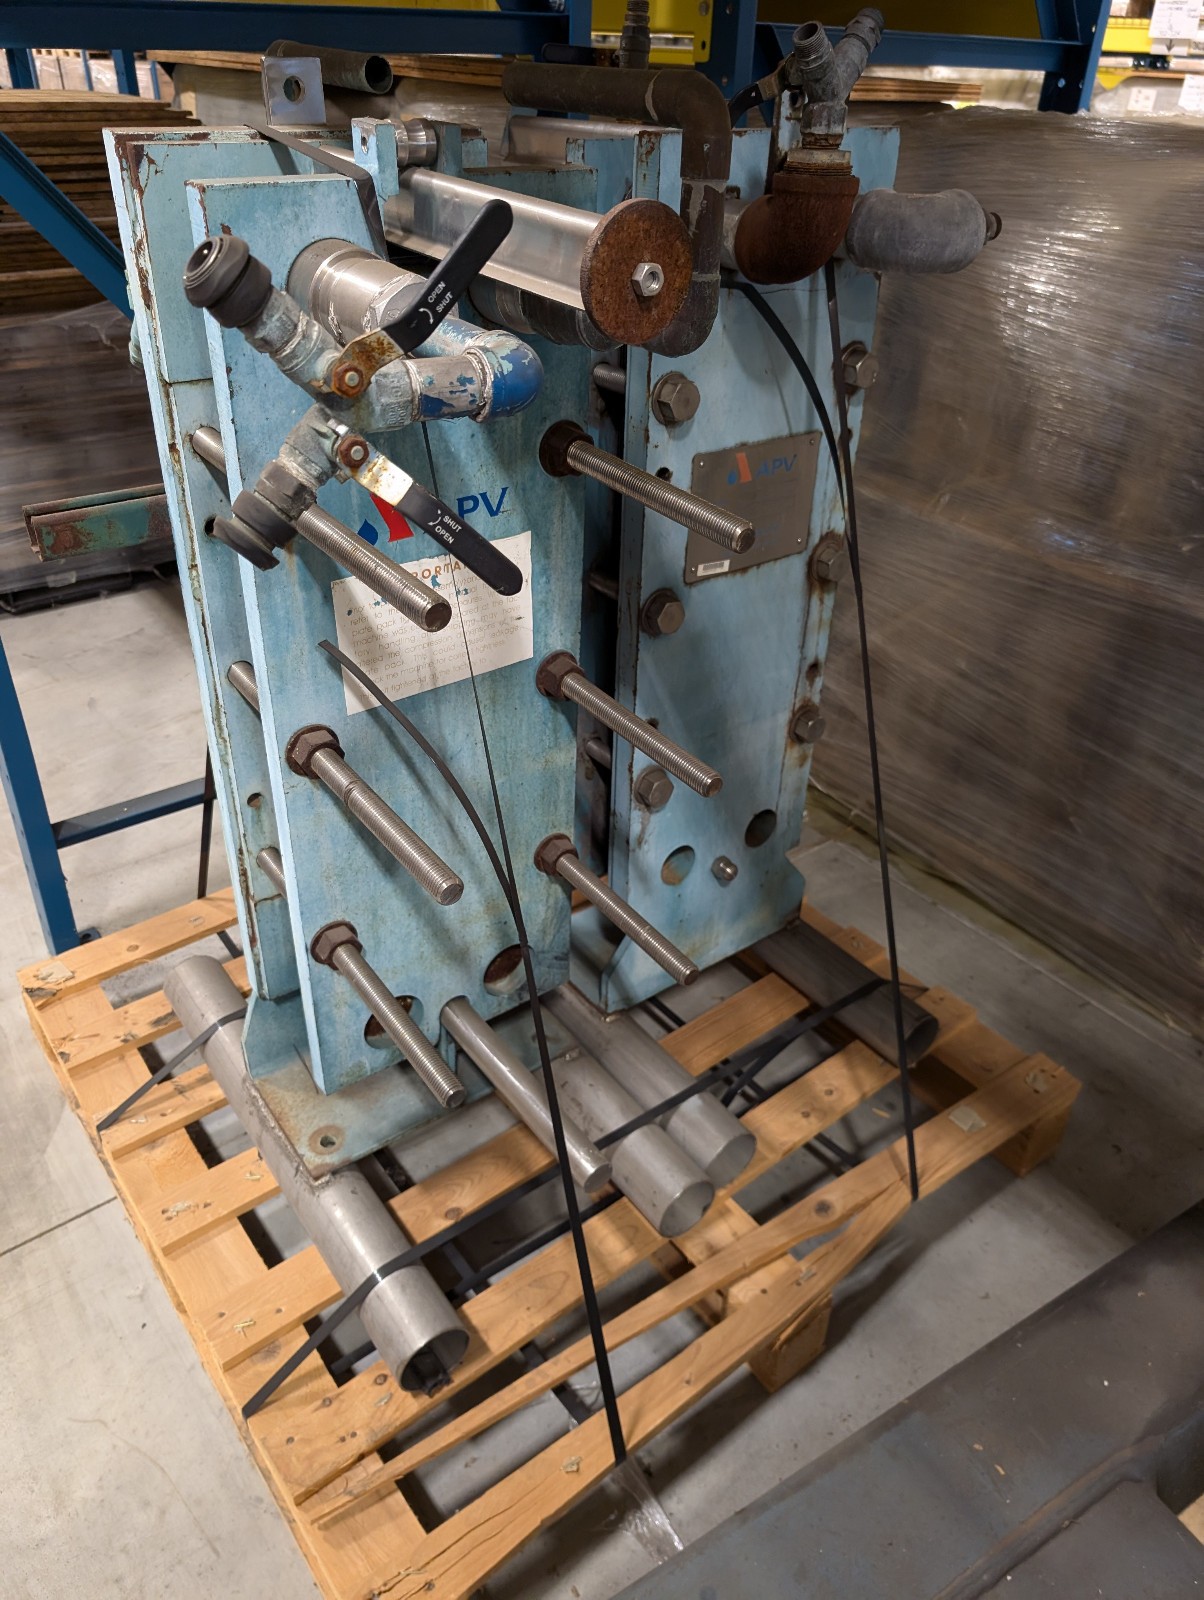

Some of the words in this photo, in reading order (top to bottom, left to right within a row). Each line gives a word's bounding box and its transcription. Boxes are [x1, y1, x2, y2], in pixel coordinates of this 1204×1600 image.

[428, 281, 446, 303] OPEN
[436, 291, 453, 313] SHUT
[756, 454, 797, 478] APV
[456, 486, 509, 520] PV
[435, 525, 455, 544] OPEN
[442, 515, 462, 533] SHUT
[378, 633, 416, 653] handling
